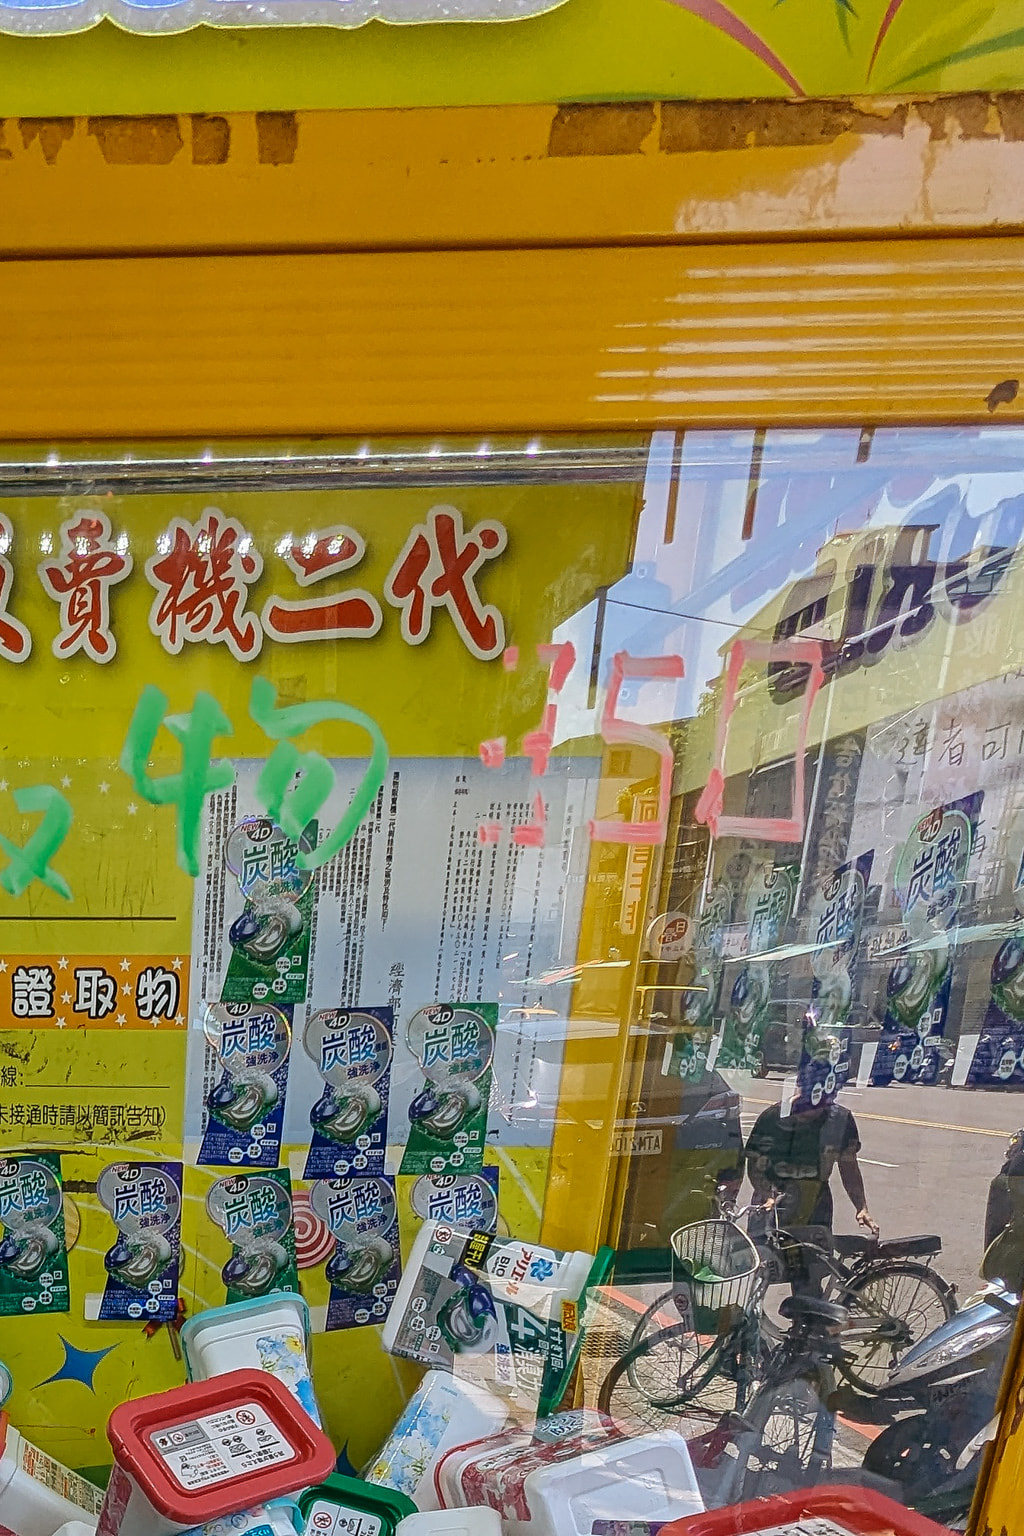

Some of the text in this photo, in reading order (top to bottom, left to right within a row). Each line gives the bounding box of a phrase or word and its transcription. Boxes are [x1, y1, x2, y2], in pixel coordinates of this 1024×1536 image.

[250, 826, 271, 841] 4D
[241, 837, 299, 888] 炭酸
[229, 1001, 248, 1015] 4D
[432, 1010, 453, 1024] 4D
[328, 1014, 349, 1029] 4D
[220, 1014, 276, 1057] 炭酸
[422, 1020, 480, 1070] 炭酸
[320, 1024, 377, 1073] 炭酸
[1, 1161, 19, 1175] 4D
[120, 1165, 139, 1179] 4D
[229, 1178, 247, 1193] 4D
[332, 1178, 352, 1190] 4D
[435, 1174, 456, 1189] 4D
[114, 1178, 168, 1221] 炭酸
[329, 1181, 383, 1231] 炭酸
[428, 1184, 482, 1224] 炭酸
[224, 1188, 279, 1236] 炭酸
[495, 1255, 511, 1278] BIO
